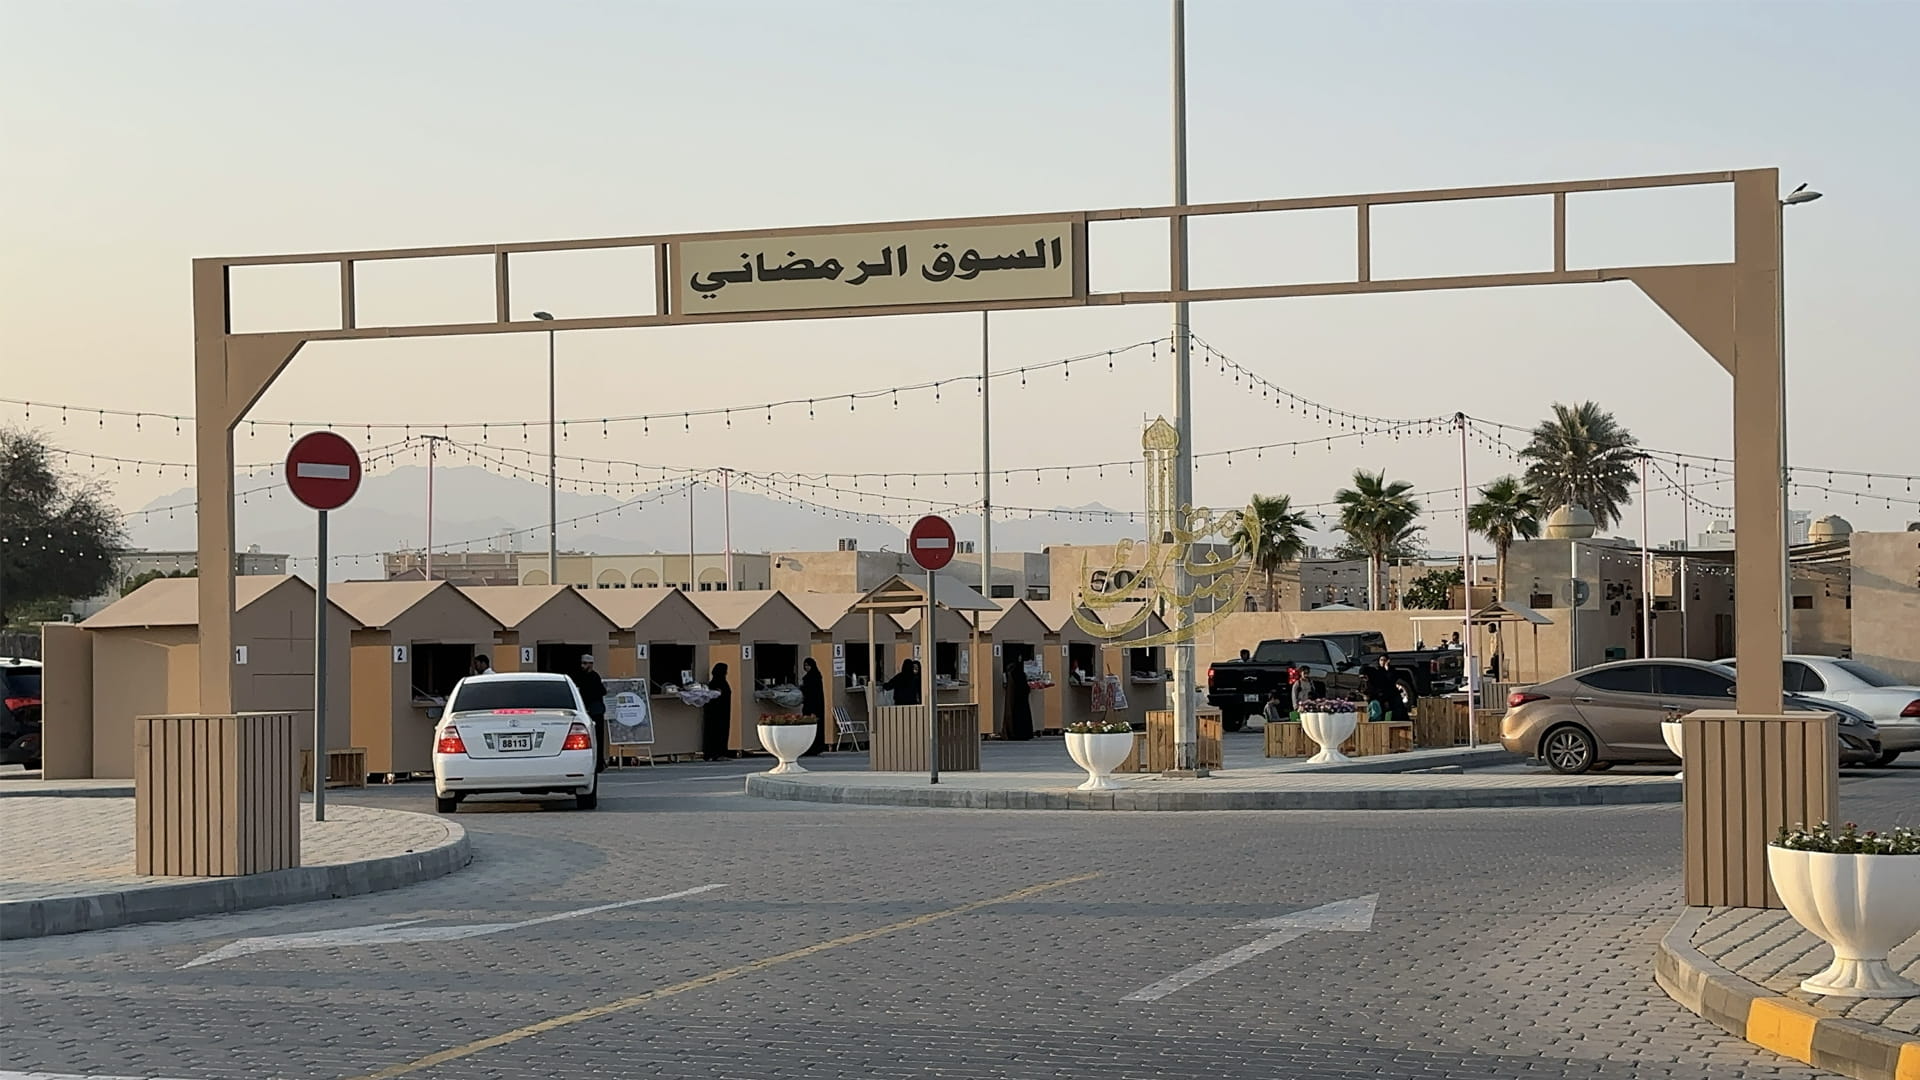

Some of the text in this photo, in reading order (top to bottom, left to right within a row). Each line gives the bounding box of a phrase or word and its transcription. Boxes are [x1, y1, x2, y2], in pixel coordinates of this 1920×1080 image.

[690, 236, 1062, 299] السوق الرمضاني
[397, 647, 404, 661] 2
[524, 649, 530, 662] 3
